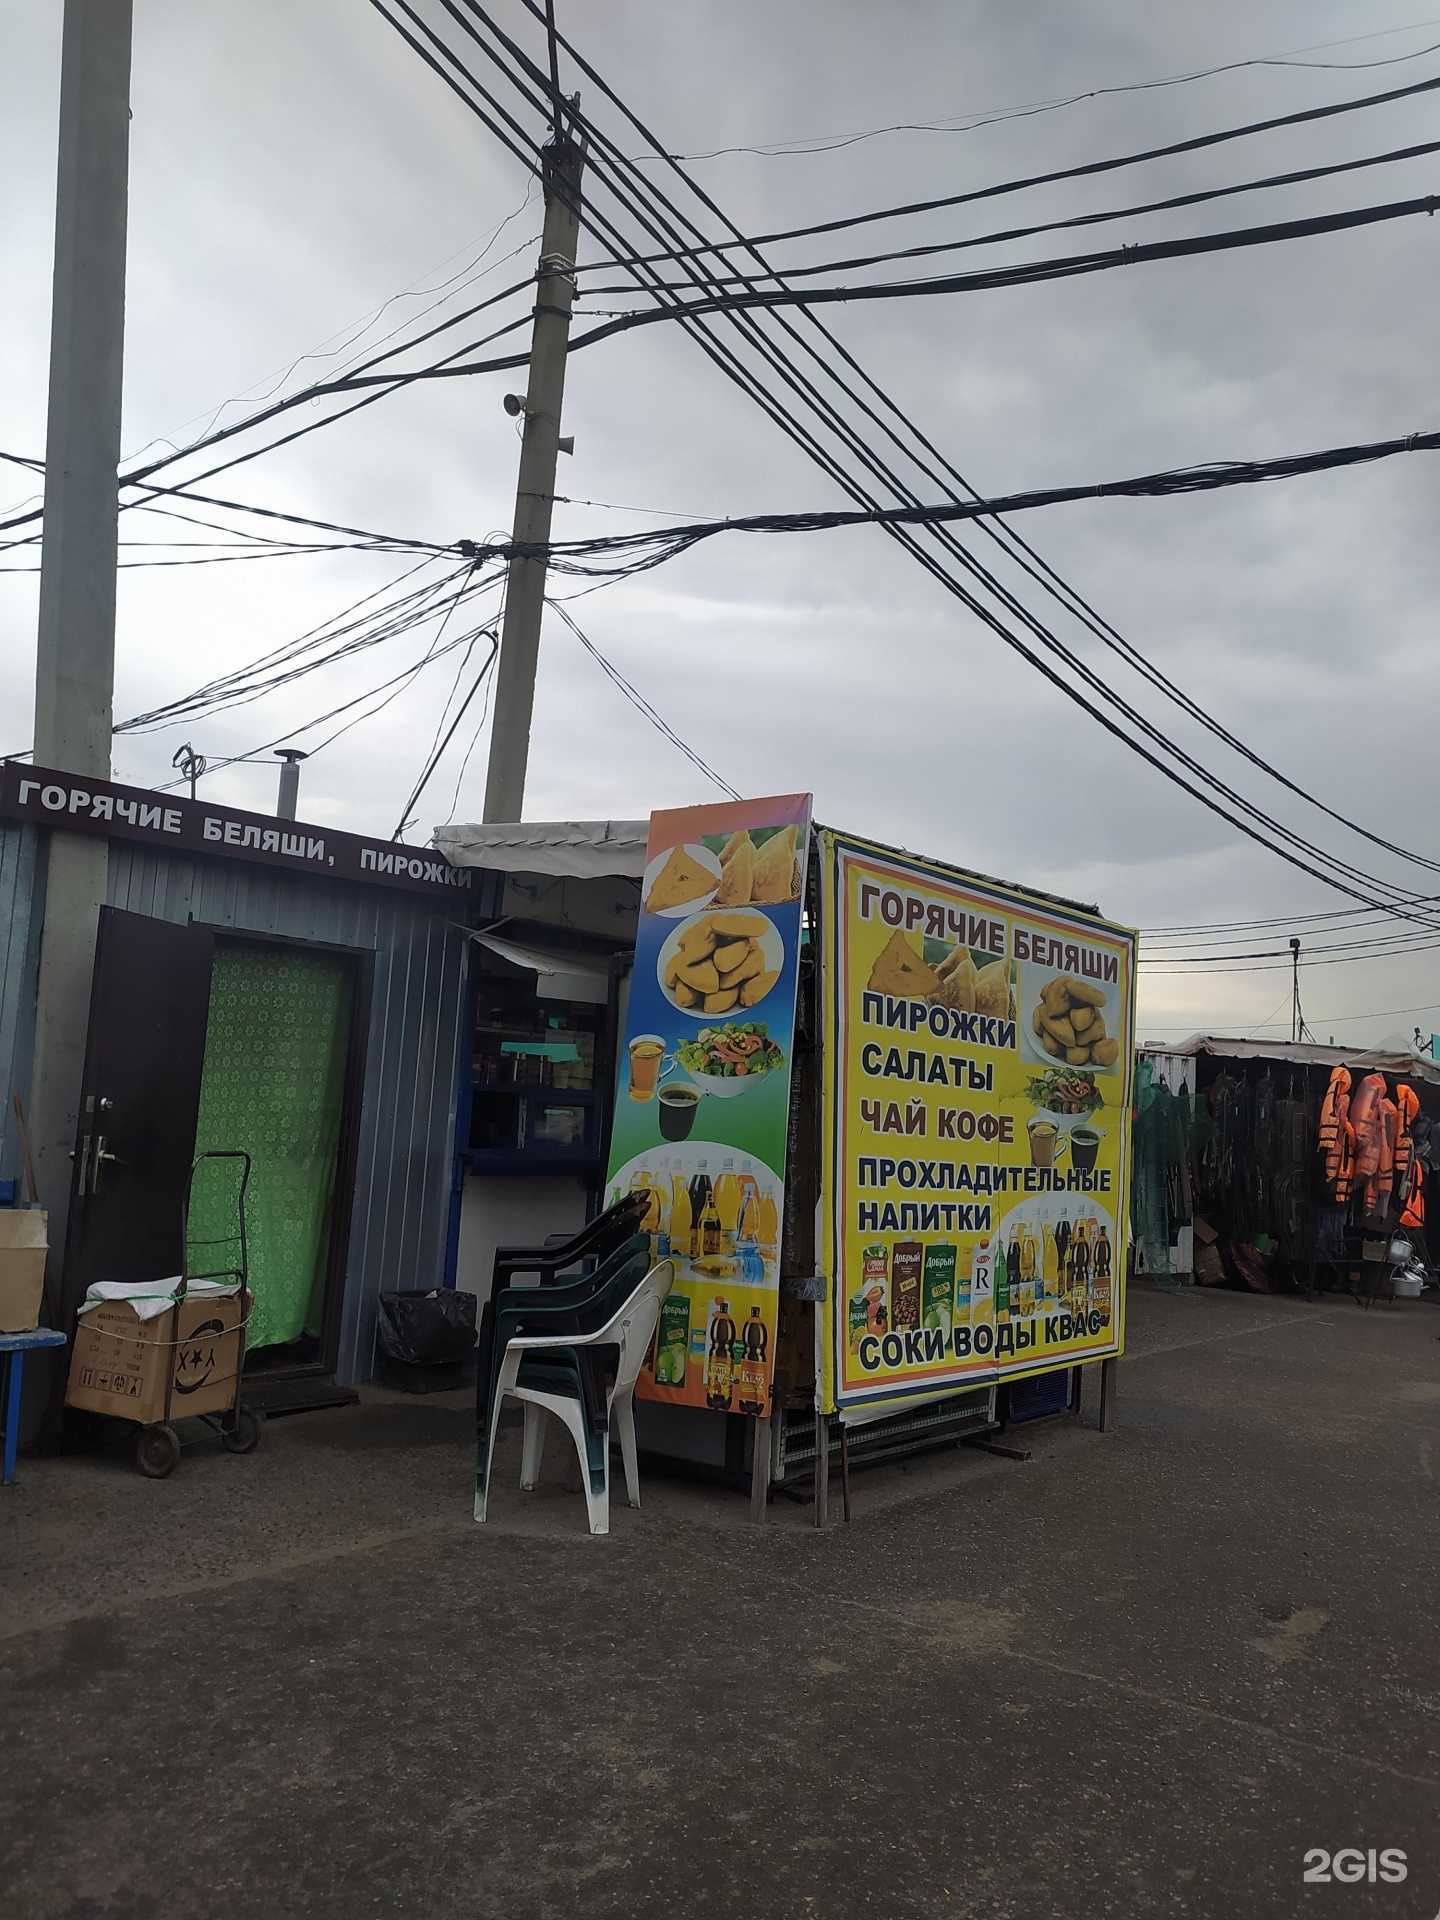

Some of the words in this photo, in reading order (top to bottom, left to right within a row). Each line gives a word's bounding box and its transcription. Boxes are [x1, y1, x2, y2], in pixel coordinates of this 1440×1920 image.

[18, 780, 183, 834] ГОРЯЧИЕ
[203, 817, 335, 867] БЕЛЯШИ,
[360, 848, 472, 888] ПИРОЖКИ
[861, 884, 1005, 954] ГОРЯЧИЕ
[1014, 929, 1119, 984] БЕЛЯШИ
[862, 992, 1016, 1049] ПИРОЖКИ
[862, 1043, 992, 1091] САЛАТЫ
[860, 1098, 927, 1136] ЧАЙ
[938, 1108, 1014, 1143] КОФЕ
[858, 1157, 1111, 1195] ПРОХЛАДИТЕЛЬНЫЕ
[858, 1202, 991, 1231] НАПИТКИ
[926, 1256, 954, 1270] Добрый
[858, 1329, 943, 1369] СОКИ
[954, 1319, 1036, 1358] ВОДЫ
[1045, 1311, 1101, 1344] КВАС
